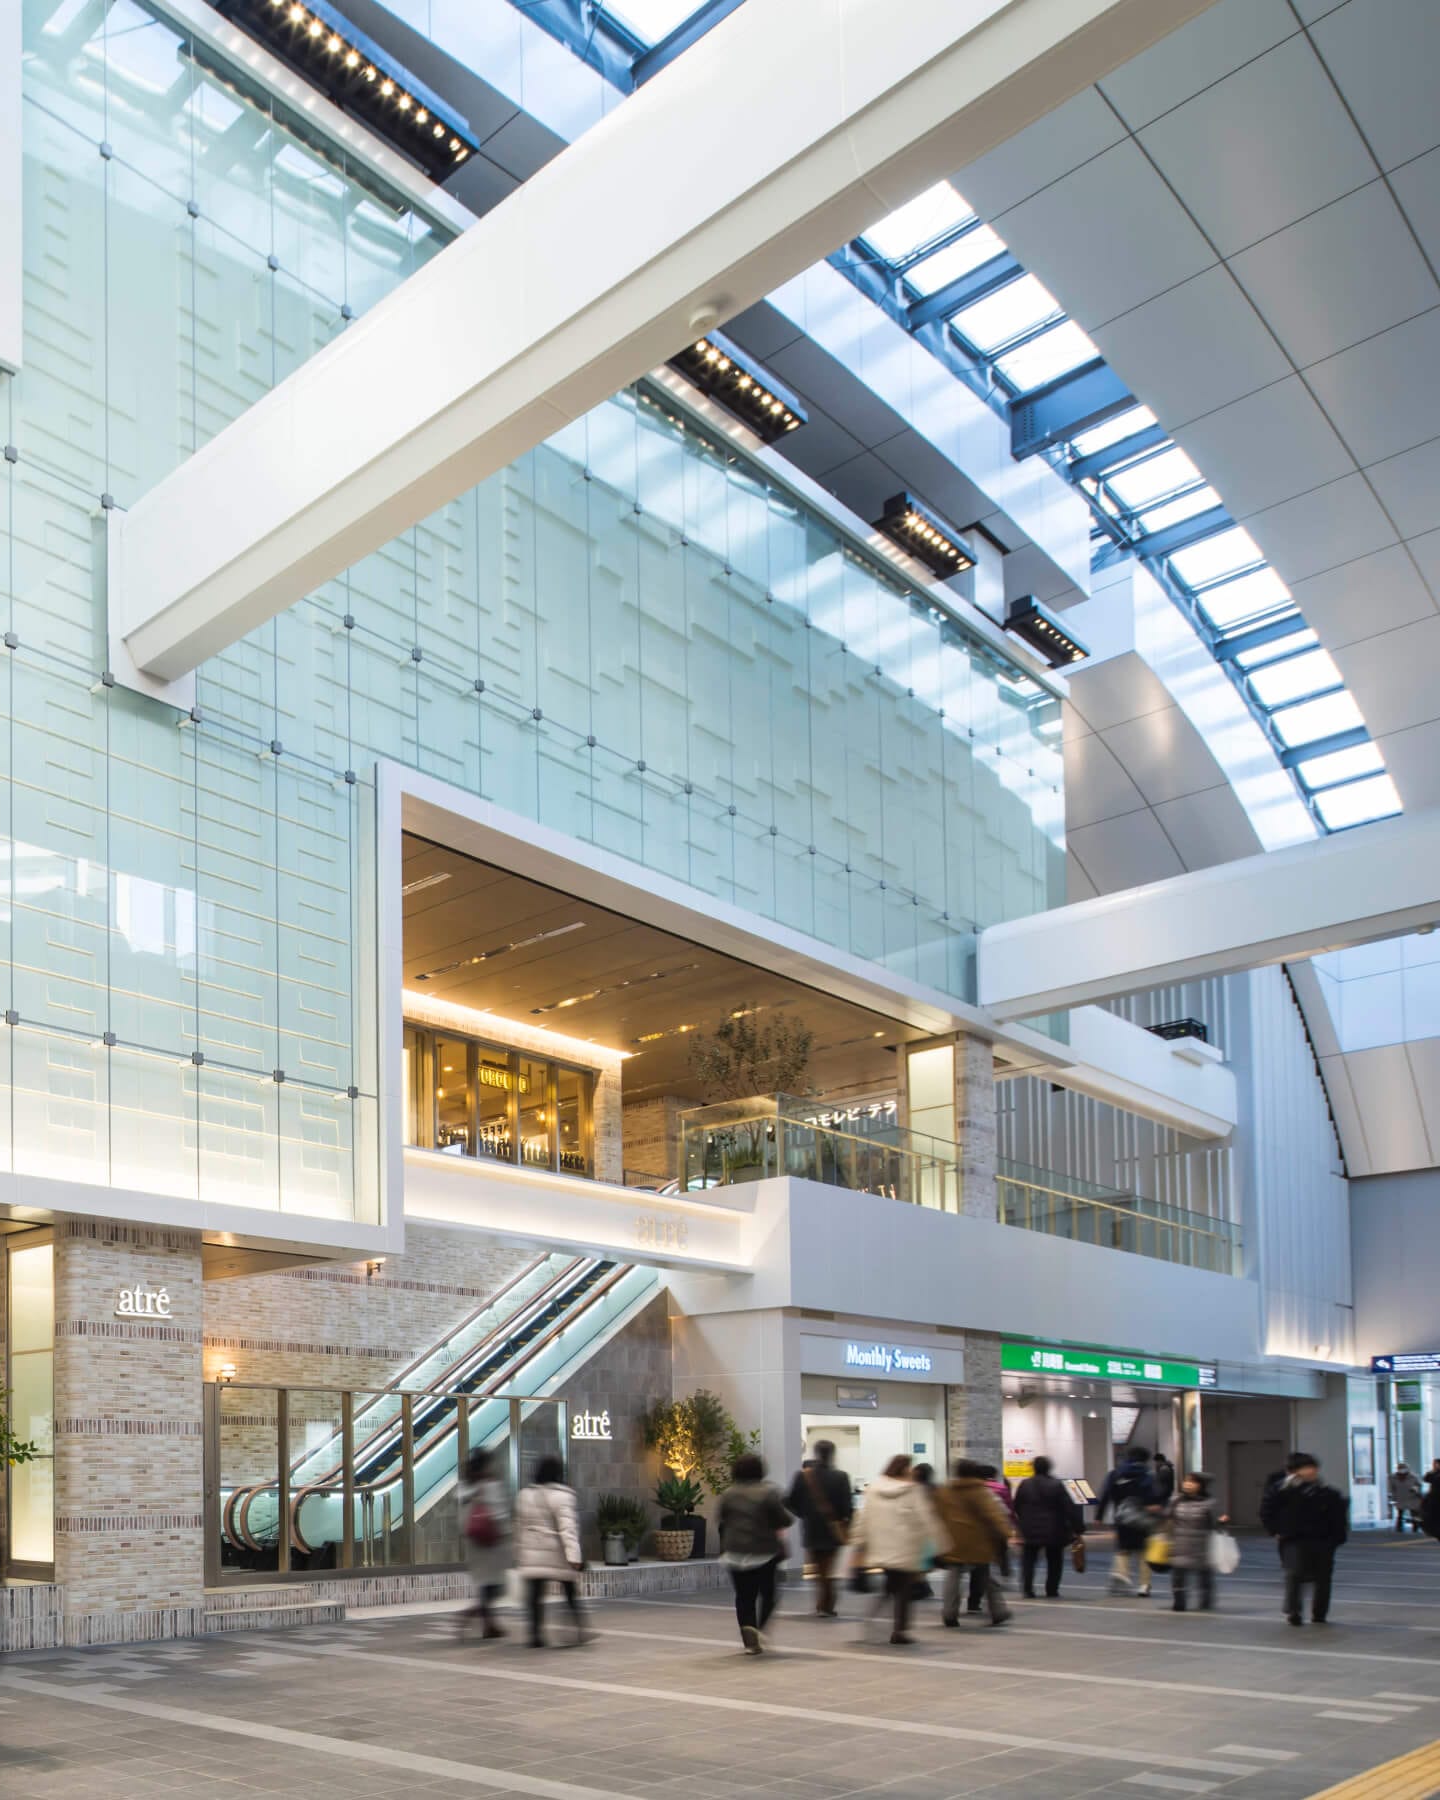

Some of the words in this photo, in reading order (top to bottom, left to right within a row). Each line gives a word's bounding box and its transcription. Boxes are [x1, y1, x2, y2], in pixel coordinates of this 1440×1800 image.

[119, 1284, 171, 1315] atré
[846, 1344, 892, 1372] Monthly
[894, 1349, 931, 1372] Sweets
[572, 1409, 611, 1436] atré
